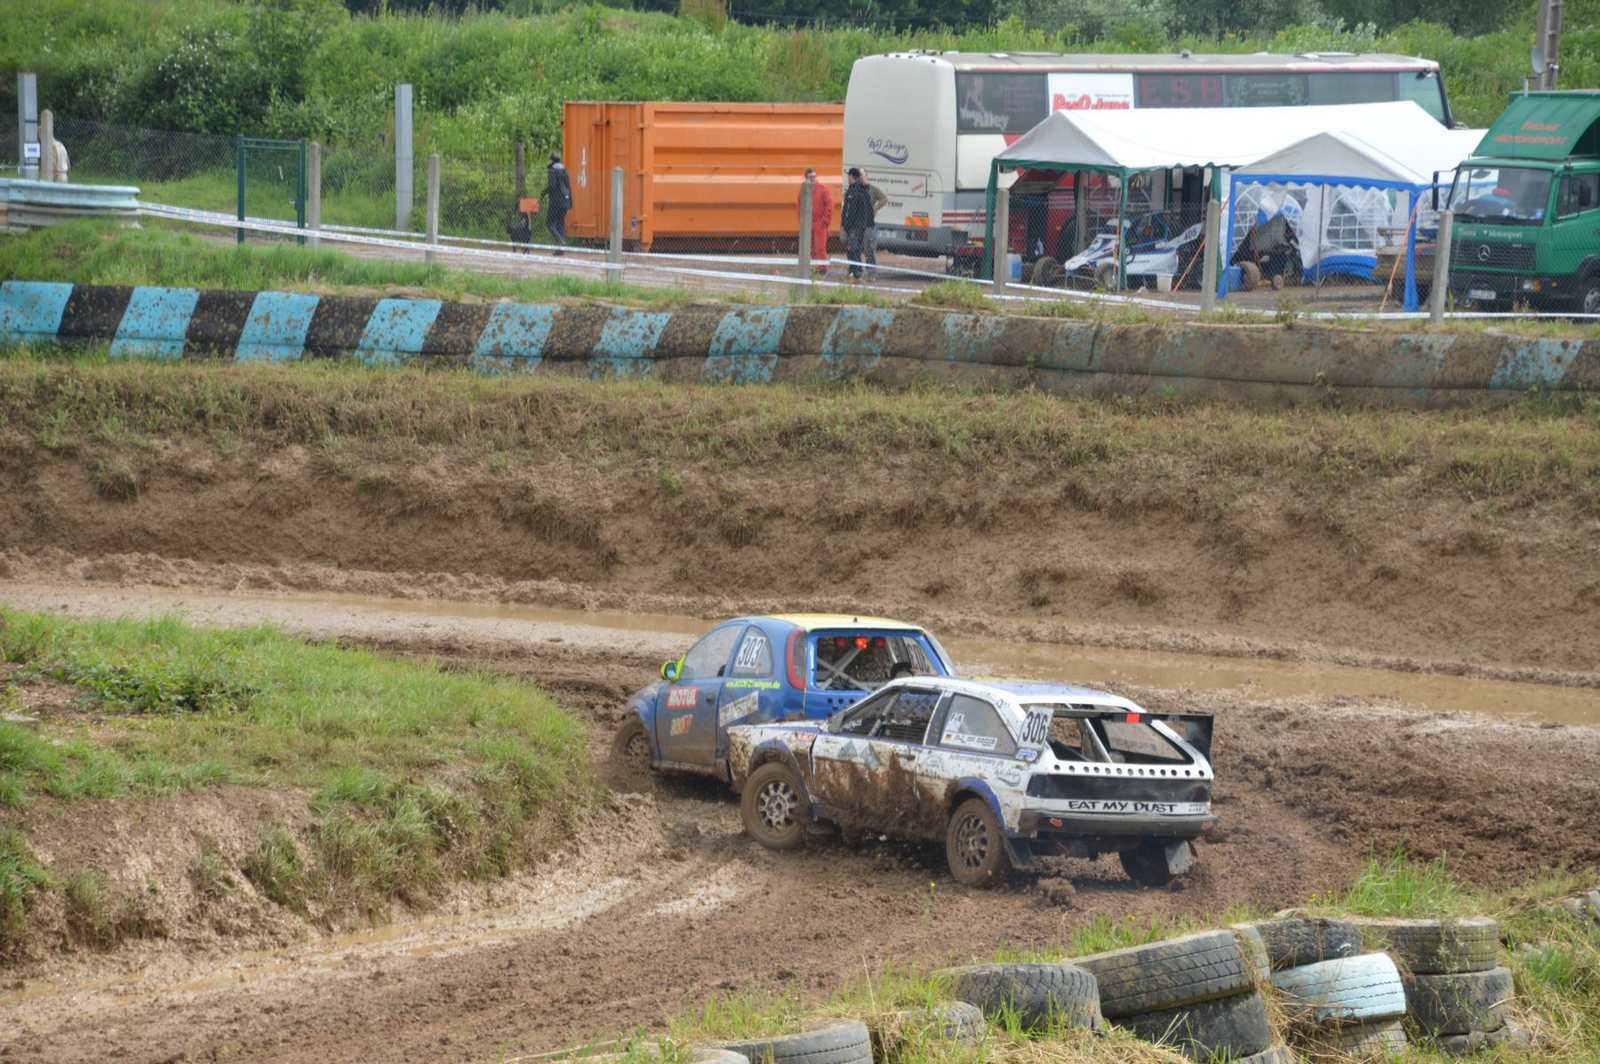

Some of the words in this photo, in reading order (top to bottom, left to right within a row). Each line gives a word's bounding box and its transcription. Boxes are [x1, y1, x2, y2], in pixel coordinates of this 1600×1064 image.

[737, 637, 765, 666] 303
[1022, 711, 1048, 744] 306
[1068, 800, 1100, 810] EAT
[1102, 801, 1129, 812] MY
[1133, 801, 1178, 813] DUST
